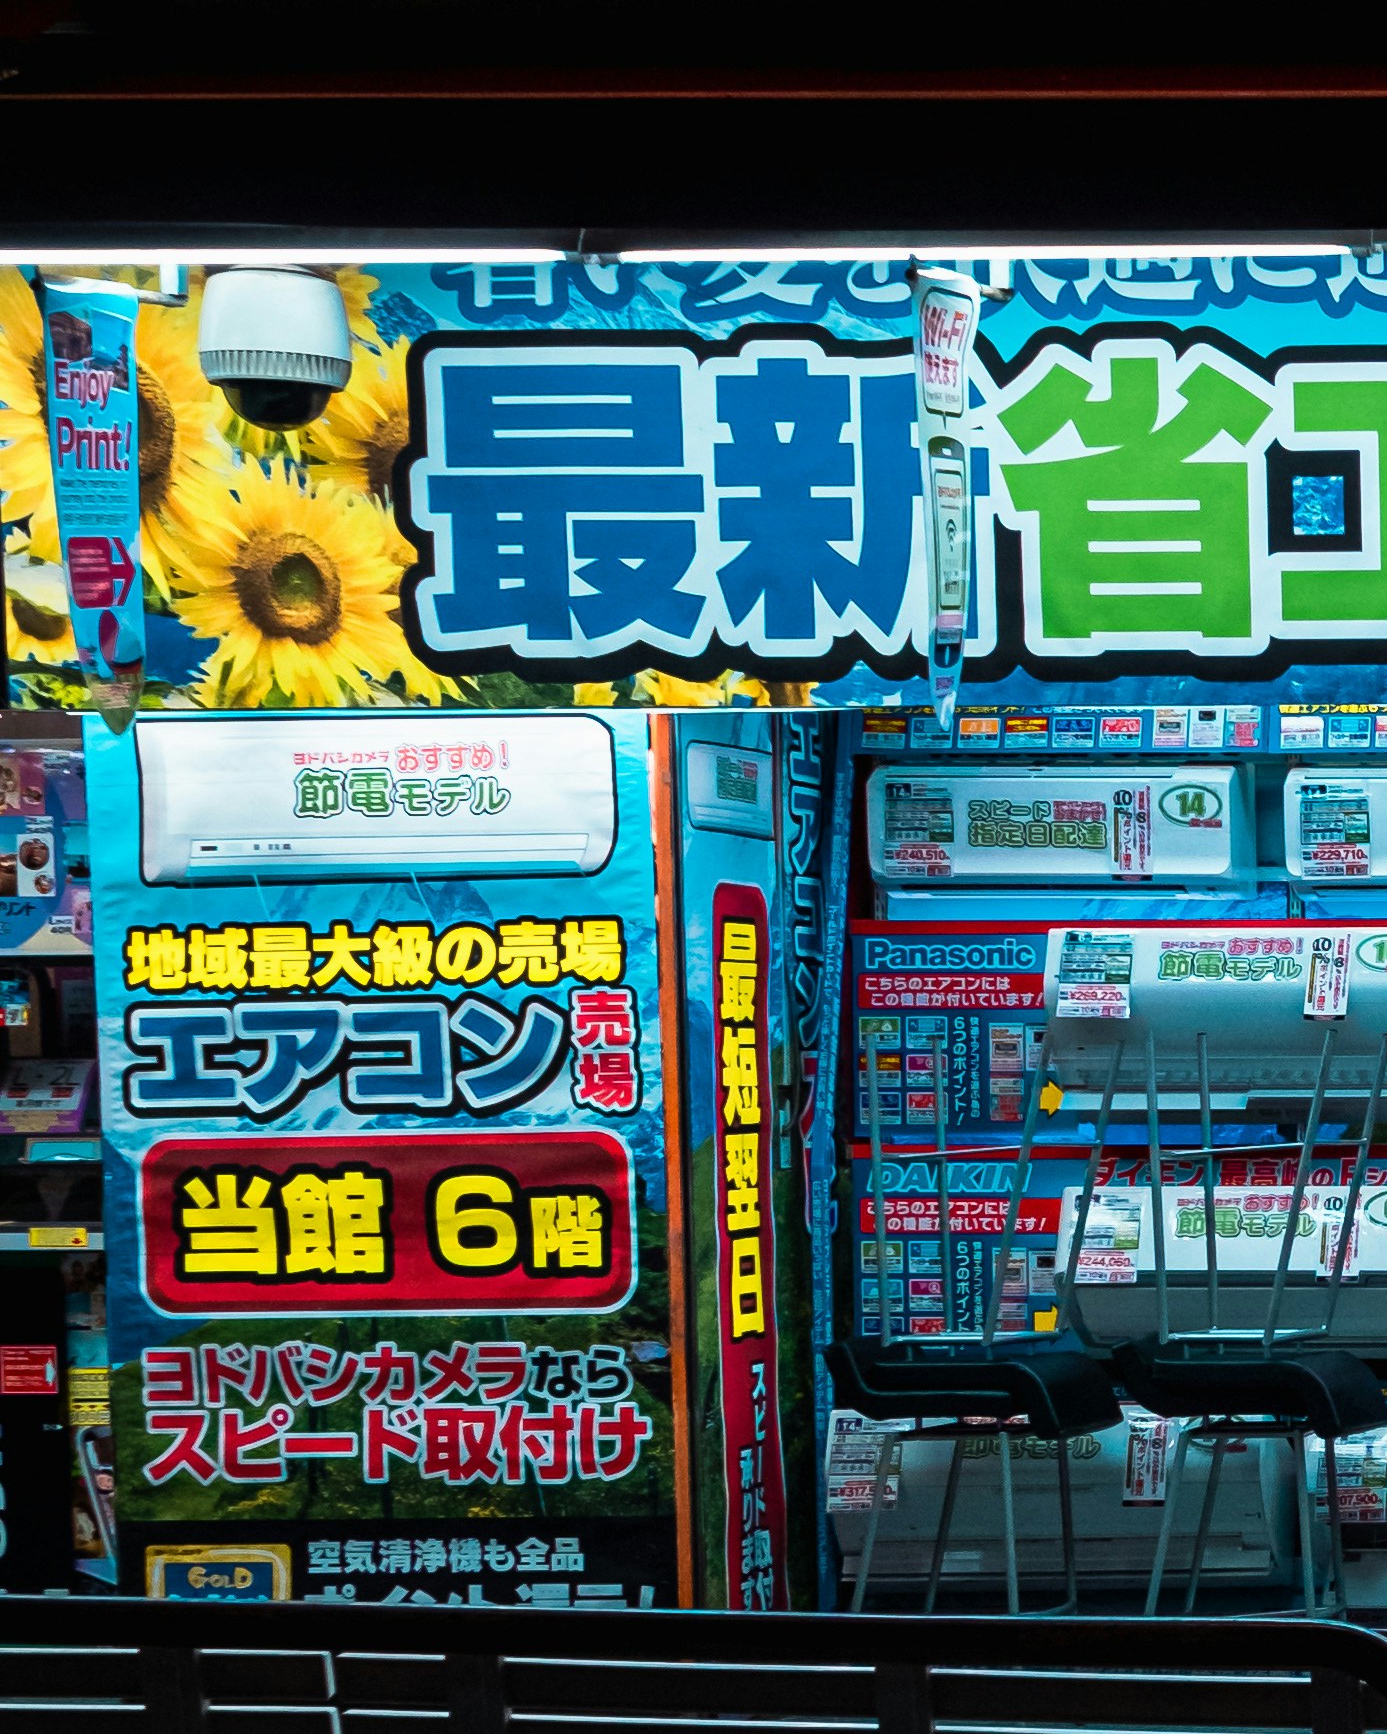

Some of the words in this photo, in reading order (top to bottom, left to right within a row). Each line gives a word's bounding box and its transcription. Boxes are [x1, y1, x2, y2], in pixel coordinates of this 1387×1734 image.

[54, 359, 115, 410] Enjoy
[56, 416, 131, 470] Print!
[294, 752, 390, 765] ヨドバシカメラ
[397, 742, 510, 772] おすすめ!
[295, 769, 511, 818] 節電モデル
[1175, 792, 1205, 816] 14
[127, 921, 621, 990] 地域最大級の売場
[866, 938, 1036, 968] Panasonic
[865, 977, 1010, 991] こちらのエアコンには
[128, 999, 566, 1114] エアコン
[573, 989, 635, 1110] 売場
[182, 1173, 385, 1276] 当館
[435, 1175, 604, 1269] 6階
[142, 1341, 633, 1407] ヨドバシカメラなら
[145, 1403, 652, 1484] スピード取付け
[308, 1539, 585, 1573] 空気清浄機も全品
